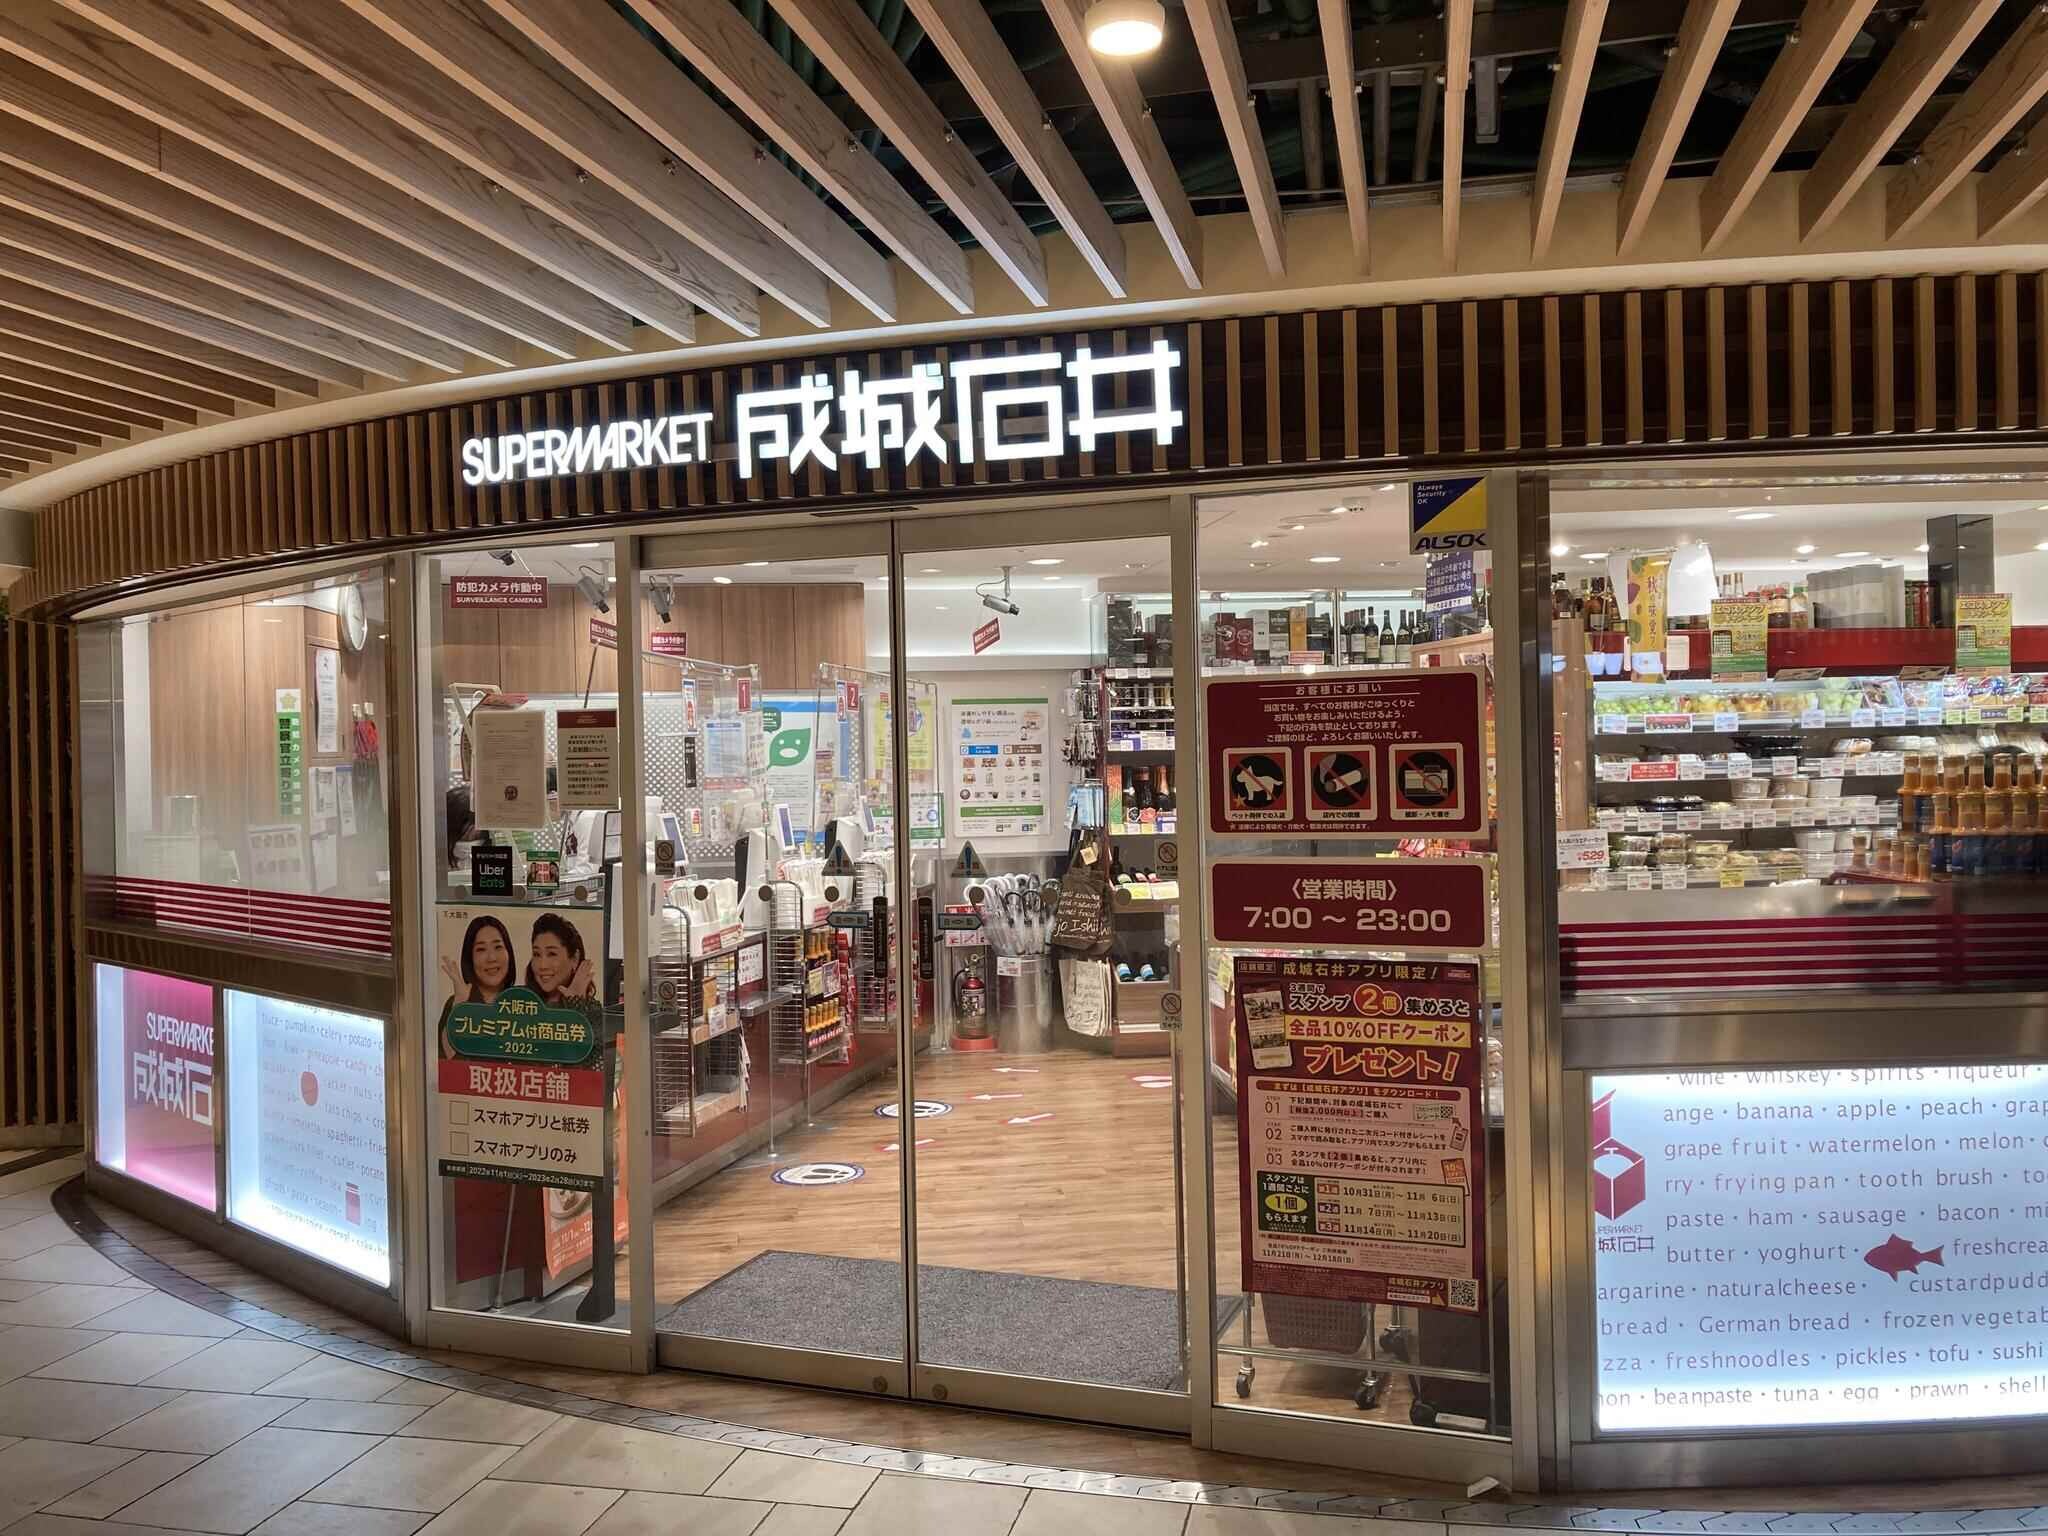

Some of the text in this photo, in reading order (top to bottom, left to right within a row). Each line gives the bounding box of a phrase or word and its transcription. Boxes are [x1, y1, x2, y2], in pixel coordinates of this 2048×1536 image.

[462, 340, 1184, 487] SUPERMARKET 成城石井
[1415, 533, 1487, 551] ALSOK
[456, 581, 543, 594] 防犯カメラ作動中
[456, 596, 543, 604] SURVEILLANCE CAMERAS
[849, 688, 856, 706] 2
[1295, 684, 1382, 696] お客様にお願い
[479, 864, 505, 875] Uber
[480, 878, 505, 888] Eats
[1243, 906, 1312, 929] 7:00
[1356, 908, 1451, 932] 23:00
[499, 999, 539, 1016] 大阪市
[455, 1017, 586, 1043] プレミアム付商品券
[1289, 1020, 1466, 1043] 全品10%OFFクーポン
[469, 1065, 570, 1101] 取扱店舗
[1265, 1102, 1280, 1114] 01
[1664, 1106, 1714, 1125] ange
[1737, 1102, 1814, 1120] banana
[1837, 1099, 1897, 1120] apple
[1921, 1097, 1983, 1119] peach
[473, 1108, 590, 1135] スマホアプリと紙券
[1266, 1128, 1282, 1140] 02
[473, 1140, 578, 1164] スマホアプリのみ
[1664, 1132, 2024, 1160] grape fruit watermelon melon
[1266, 1154, 1283, 1166] 03
[1266, 1174, 1304, 1184] スタンプは
[1665, 1179, 1693, 1196] rry
[1715, 1173, 1786, 1196] frying
[1794, 1175, 1835, 1193] pan
[1859, 1169, 1923, 1188] tooth
[1936, 1168, 1993, 1186] brush
[1276, 1196, 1298, 1210] 1個
[1266, 1213, 1308, 1224] もらえます
[1666, 1212, 1724, 1231] paste
[1748, 1208, 1793, 1226] ham
[1816, 1208, 1907, 1227] sausage
[1938, 1204, 2000, 1222] bacon
[1667, 1238, 2048, 1264] butter yoghurt freshcrea
[1598, 1282, 1686, 1304] argarine
[1707, 1278, 1856, 1297] naturalcheese
[1601, 1316, 1668, 1336] bread
[1699, 1316, 1780, 1334] German
[1788, 1312, 1850, 1331] bread
[1884, 1311, 1954, 1329] frozen
[1602, 1341, 2044, 1371] zza freshnoodles pickles tofu sushi
[1654, 1388, 1752, 1408] beanpaste
[1774, 1388, 1819, 1402] tuna
[1910, 1382, 1969, 1400] prawn
